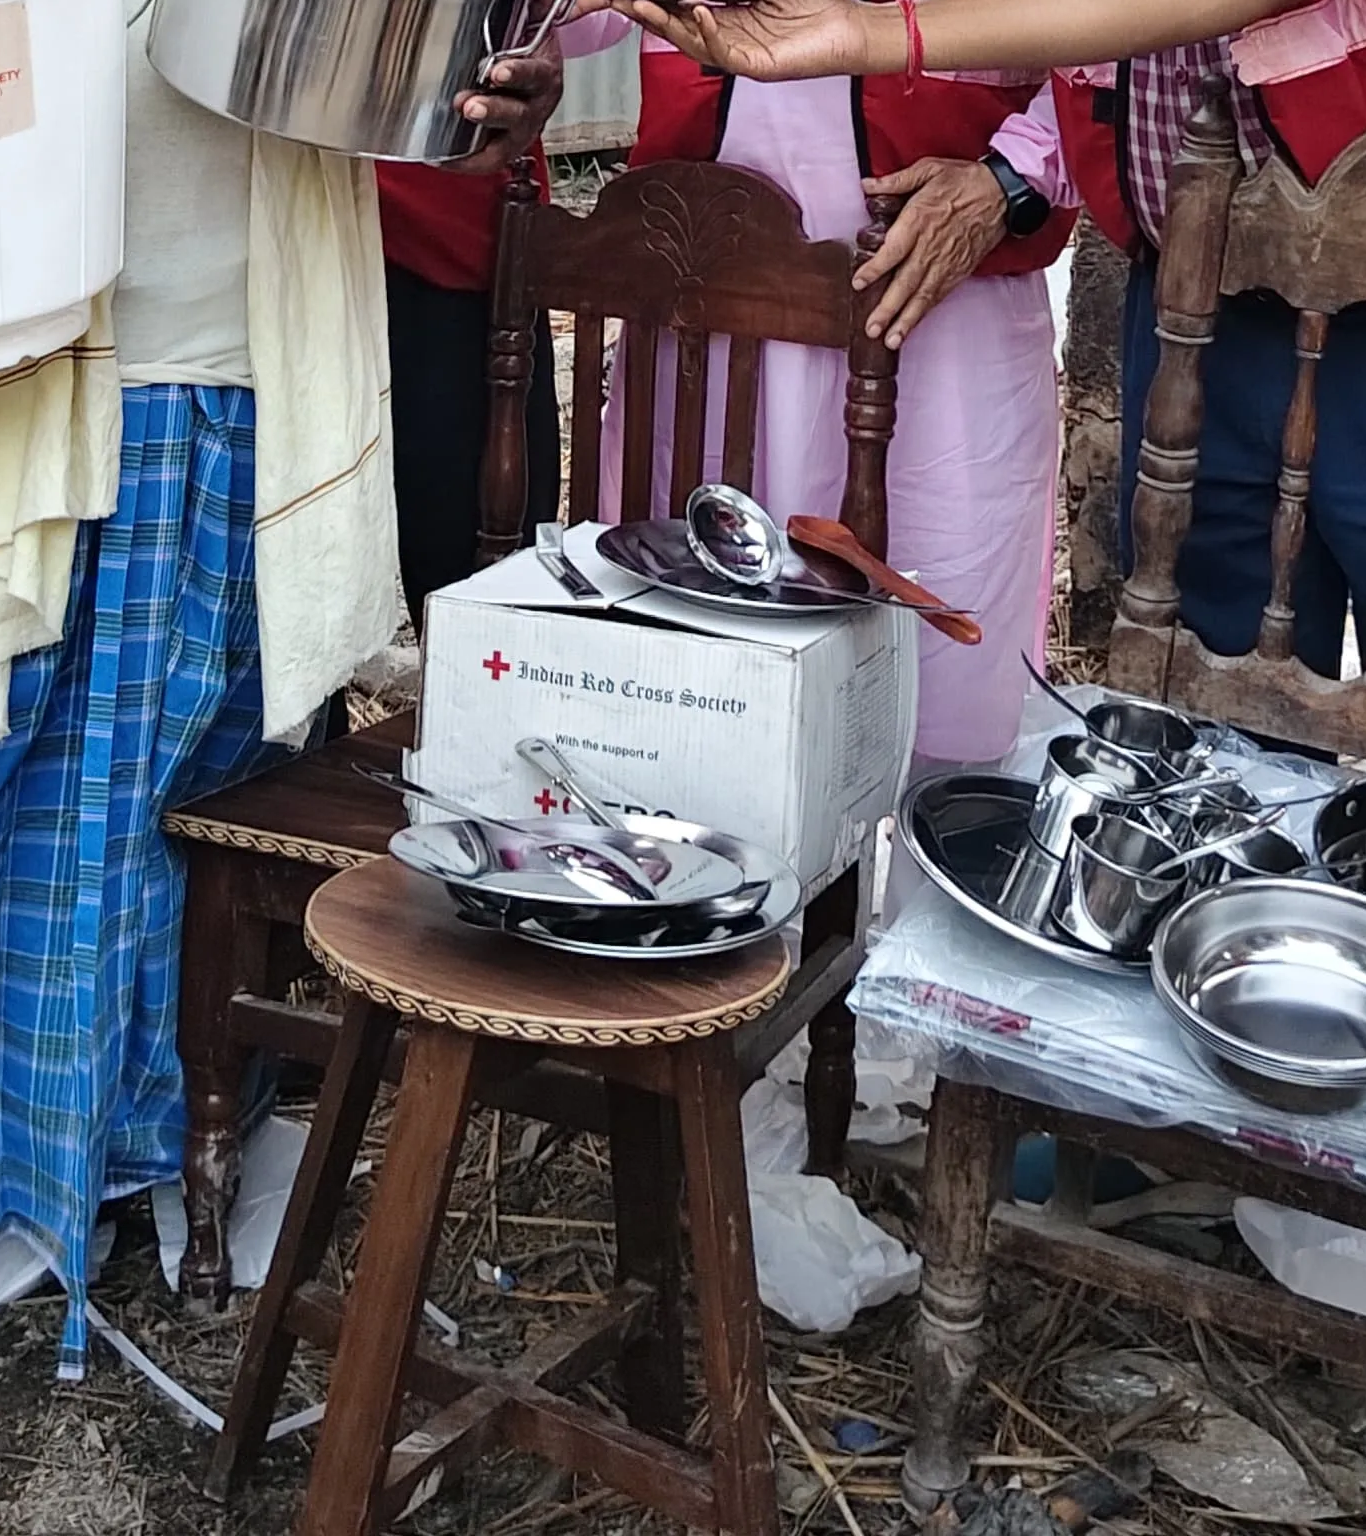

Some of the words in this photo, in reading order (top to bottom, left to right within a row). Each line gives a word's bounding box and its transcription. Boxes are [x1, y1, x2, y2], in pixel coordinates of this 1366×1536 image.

[517, 660, 574, 688] Indian
[579, 670, 615, 694] Red
[621, 678, 675, 705] Cross
[678, 688, 747, 719] Society
[554, 732, 579, 748] With
[582, 738, 599, 752] the
[601, 742, 645, 759] support
[647, 750, 660, 762] of
